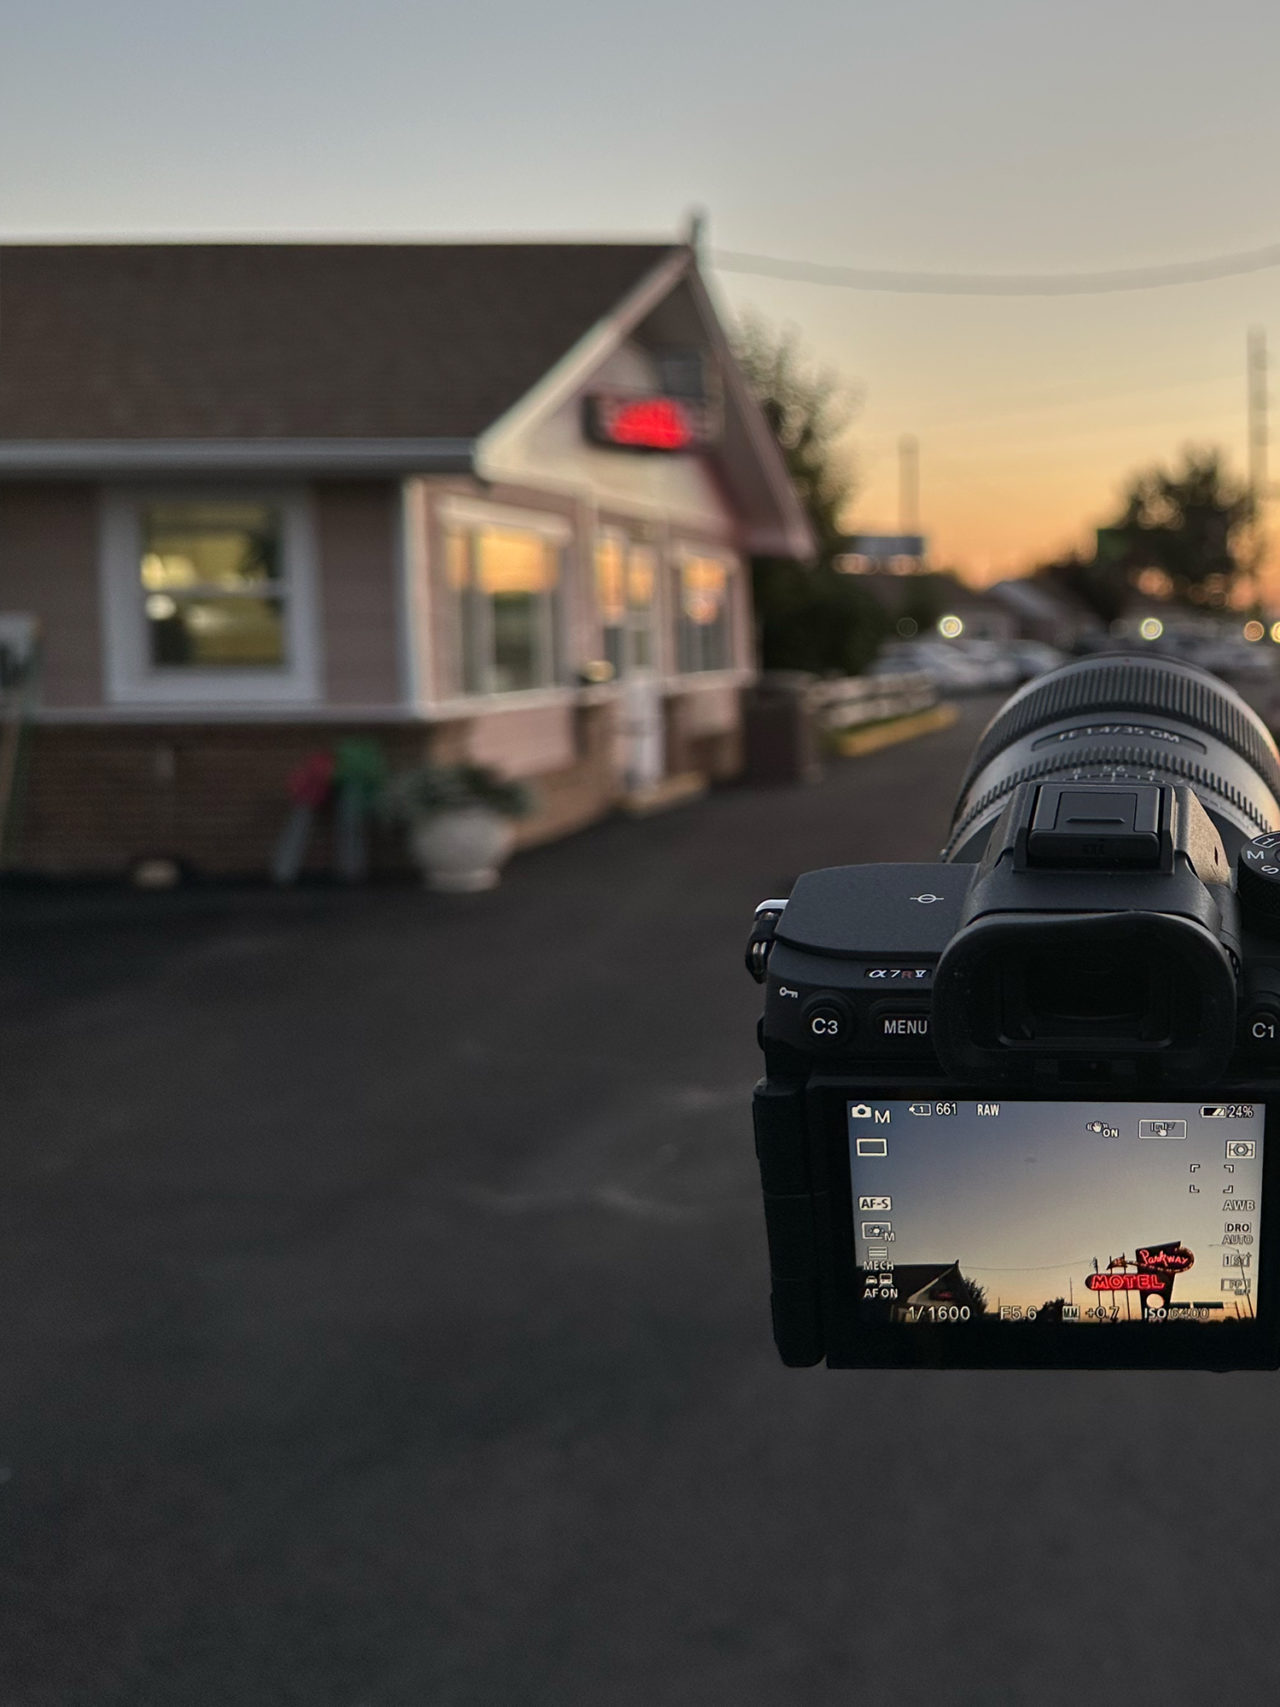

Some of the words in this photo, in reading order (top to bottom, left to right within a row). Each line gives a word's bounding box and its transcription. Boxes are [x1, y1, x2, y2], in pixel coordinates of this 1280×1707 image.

[1150, 730, 1180, 743] GM
[1262, 837, 1275, 845] 1
[1246, 850, 1264, 859] M
[1260, 865, 1279, 875] S
[811, 1017, 839, 1035] C3
[883, 1019, 928, 1034] MENU
[1252, 1022, 1275, 1039] C1
[935, 1102, 958, 1116] 661
[976, 1103, 1000, 1117] RAW
[1228, 1105, 1254, 1118] 24%
[874, 1110, 891, 1124] M
[1102, 1128, 1119, 1138] ON
[861, 1198, 890, 1209] AF-S
[1223, 1199, 1255, 1211] AWB
[1226, 1223, 1250, 1232] DRO
[884, 1232, 895, 1242] M
[1222, 1234, 1253, 1245] AUTO
[863, 1261, 894, 1271] MECH
[1090, 1273, 1165, 1290] MOTEL
[863, 1288, 878, 1299] AF
[881, 1288, 898, 1299] ON
[908, 1305, 971, 1321] 1/1600
[999, 1306, 1037, 1320] F5.6
[1085, 1305, 1120, 1320] +0.7
[1144, 1307, 1167, 1319] ISO
